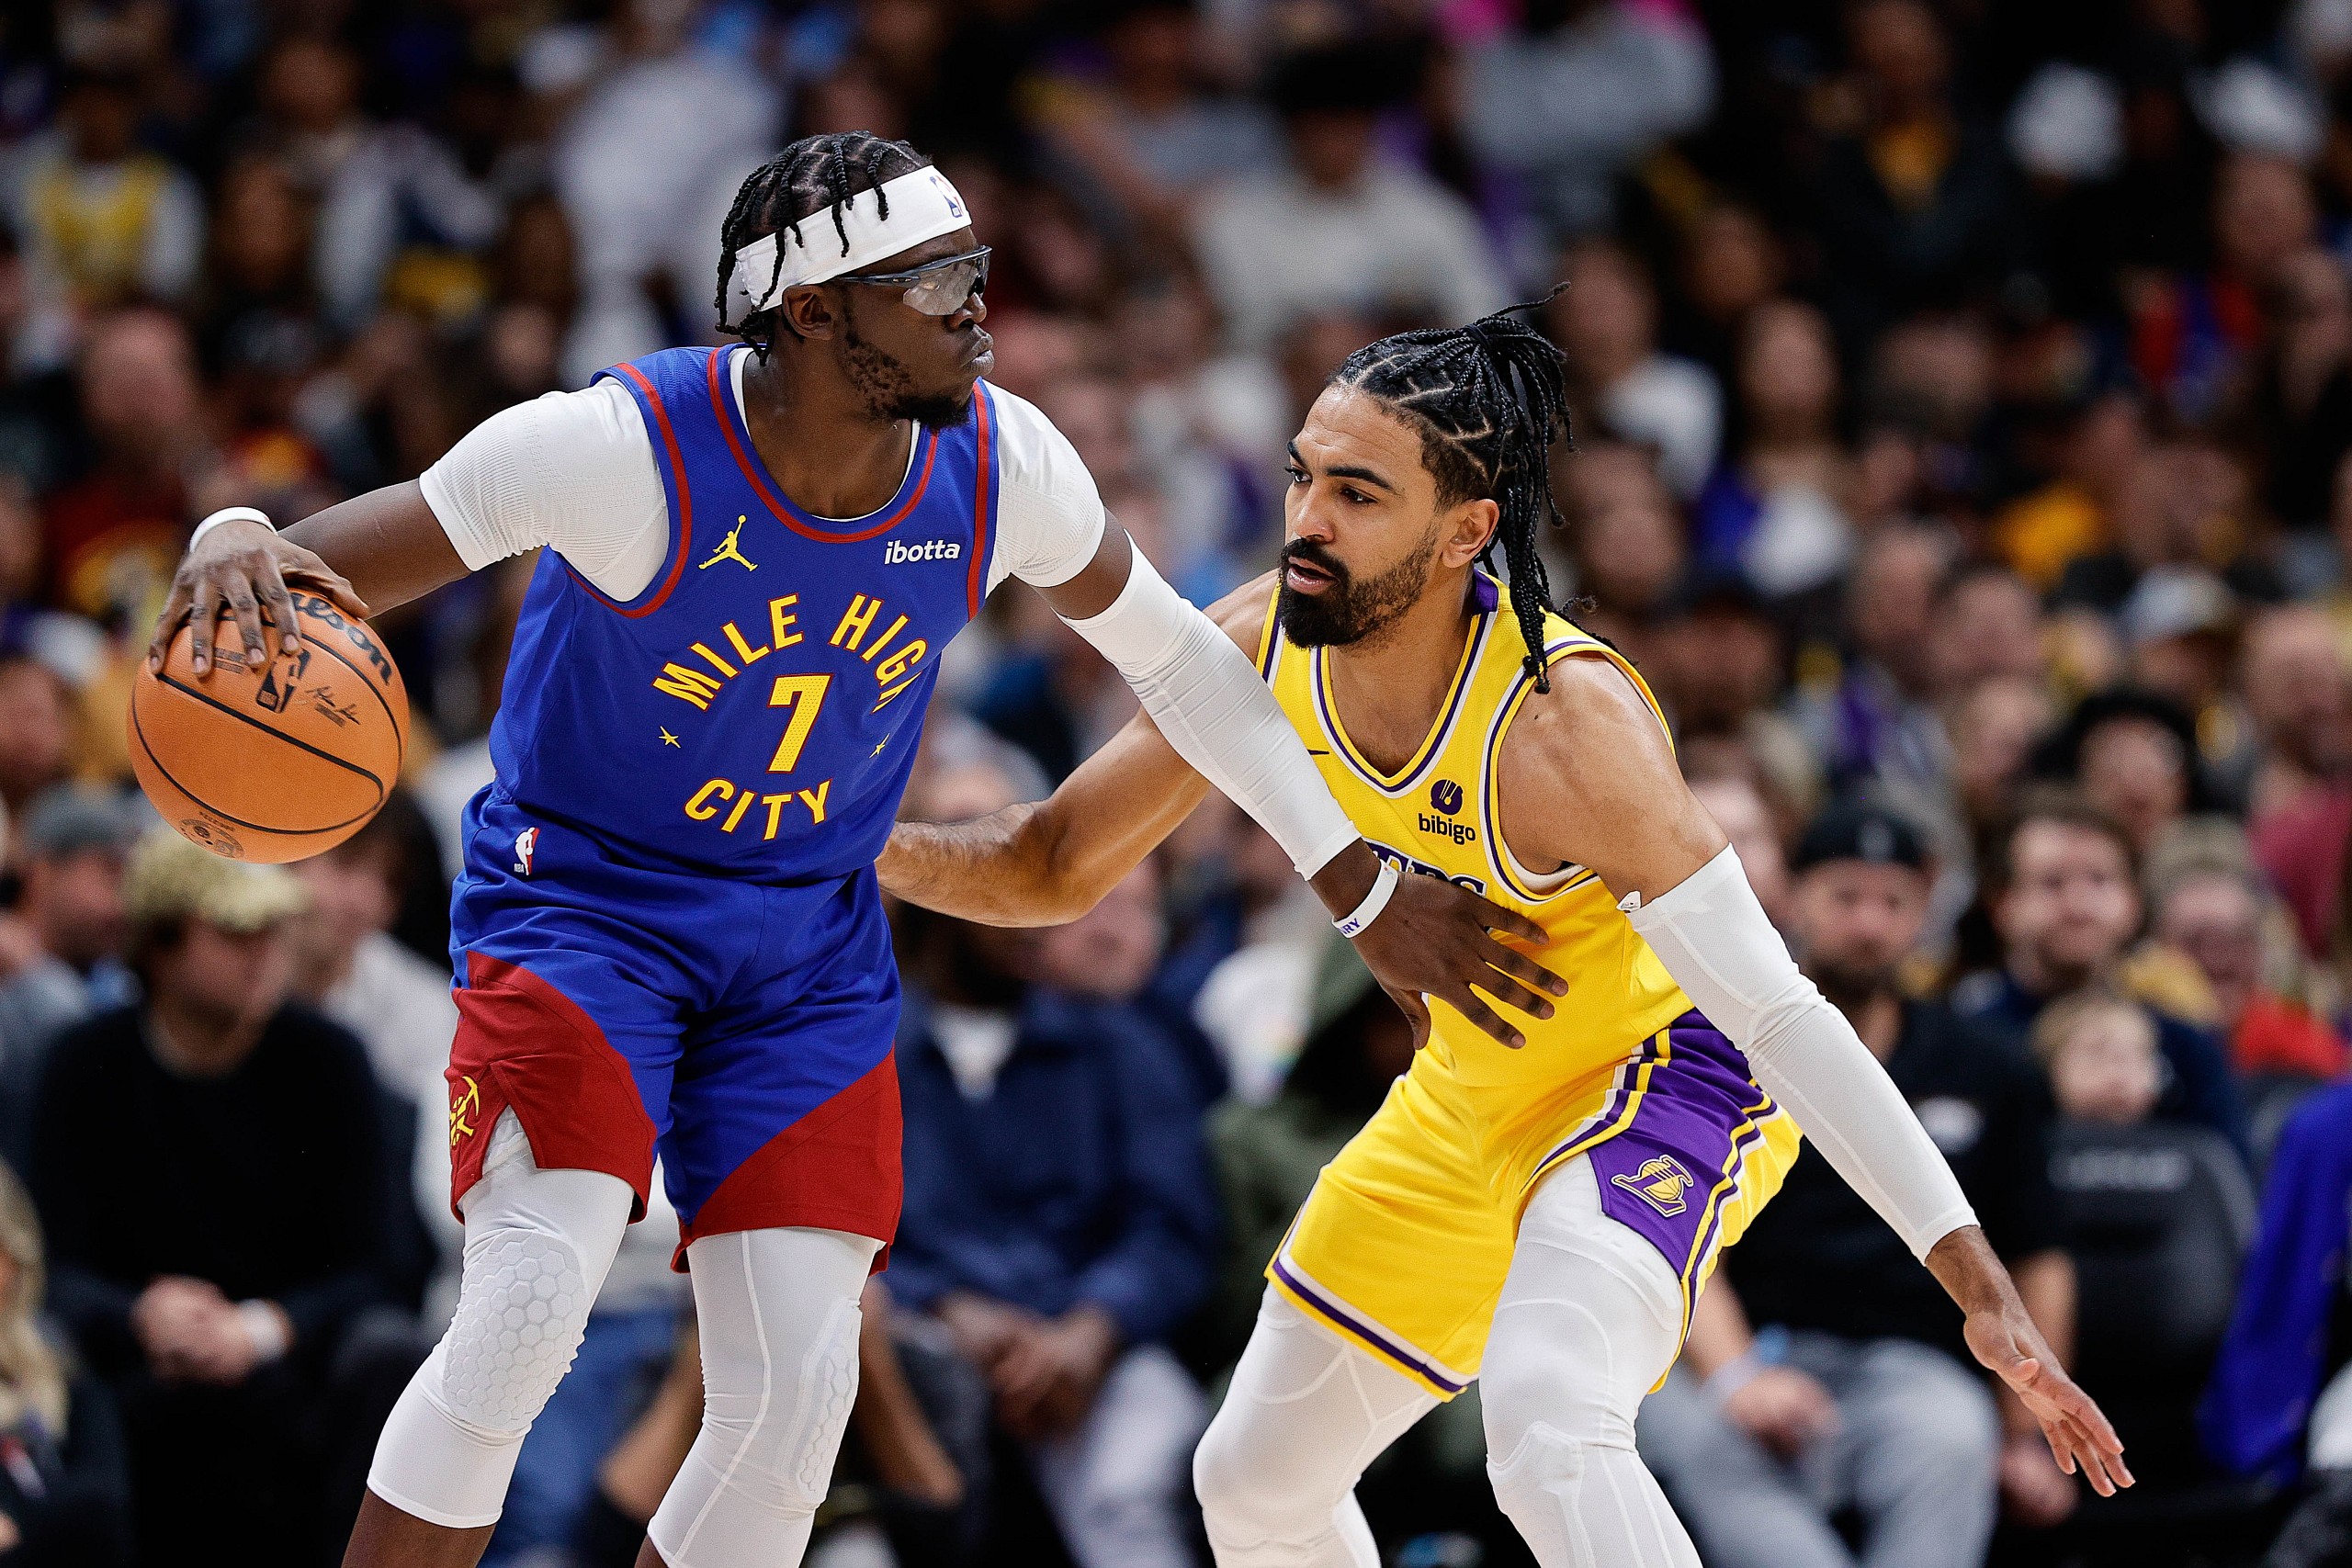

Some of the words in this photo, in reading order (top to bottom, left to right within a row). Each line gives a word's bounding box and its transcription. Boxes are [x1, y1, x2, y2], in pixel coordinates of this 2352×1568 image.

[884, 539, 961, 564] ibotta
[650, 592, 806, 712] MILE
[765, 672, 834, 774] 7
[684, 777, 833, 841] CITY
[1418, 812, 1476, 846] bibigo
